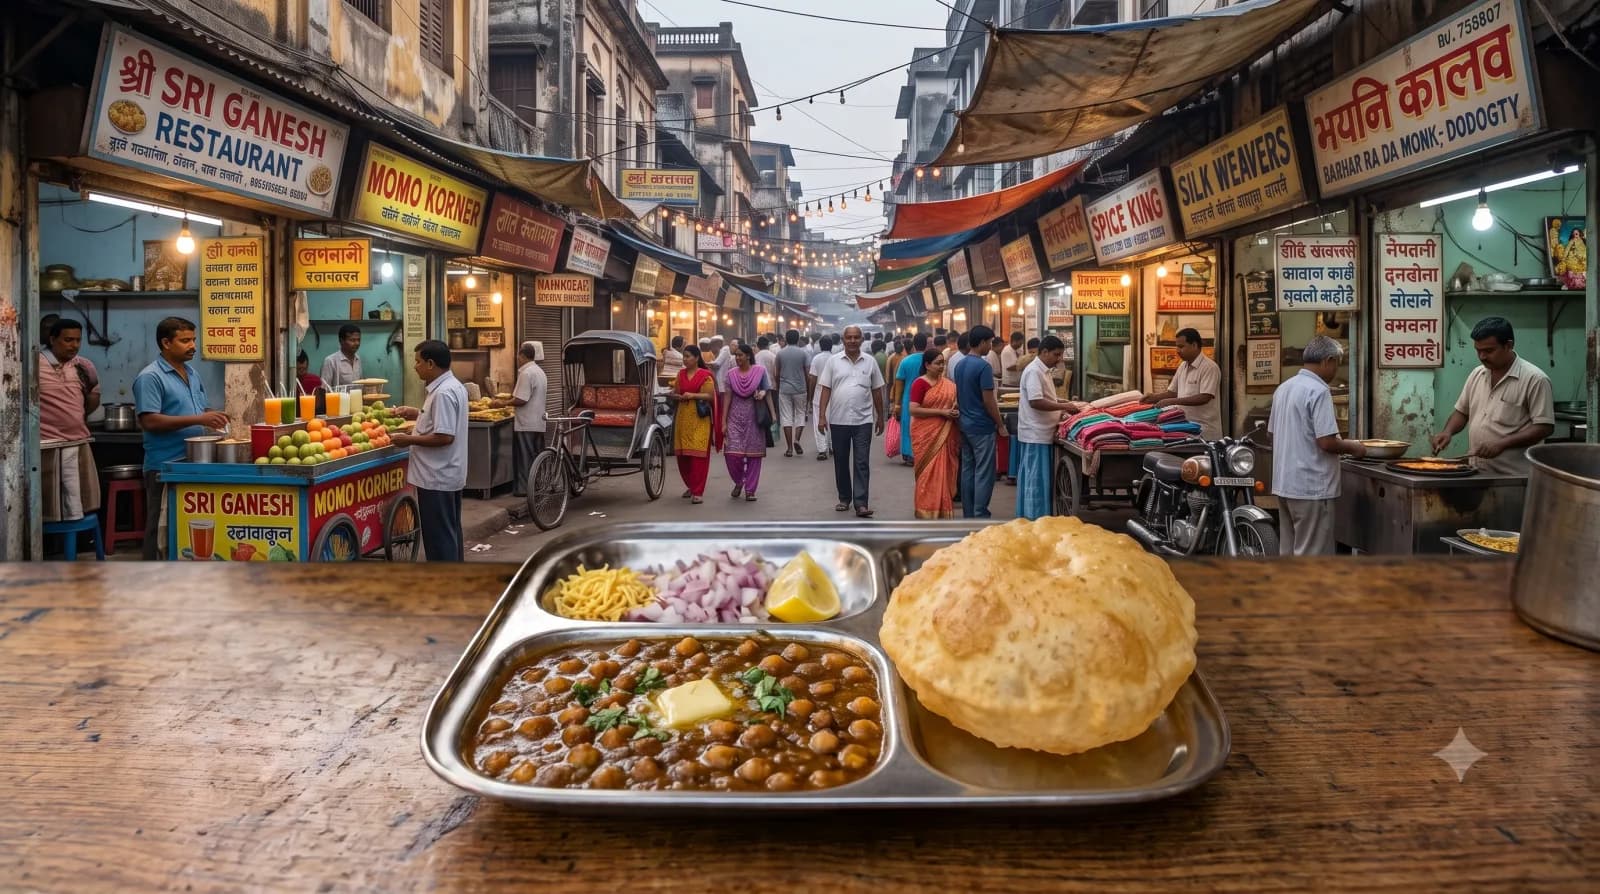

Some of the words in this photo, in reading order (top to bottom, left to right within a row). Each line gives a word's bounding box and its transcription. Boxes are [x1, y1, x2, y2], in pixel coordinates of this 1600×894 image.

[1457, 3, 1502, 39] 758807
[161, 67, 216, 119] SRI
[223, 93, 327, 158] GANESH
[1323, 153, 1363, 185] BARHAR
[1363, 147, 1380, 171] RA
[1382, 141, 1399, 165] DA
[1447, 93, 1519, 143] DODOGTY
[155, 112, 303, 182] RESTAURANT
[1178, 163, 1214, 206] SILK
[1212, 126, 1291, 192] WEAVERS
[367, 161, 423, 208] MOMO
[424, 183, 482, 228] KORNER
[1091, 203, 1128, 242] SPICE
[1127, 187, 1163, 229] KING
[1098, 301, 1126, 310] SNACKS
[184, 491, 215, 515] SRI
[221, 492, 294, 517] GANESH
[314, 484, 354, 519] MOMO
[357, 467, 405, 503] KORNER
